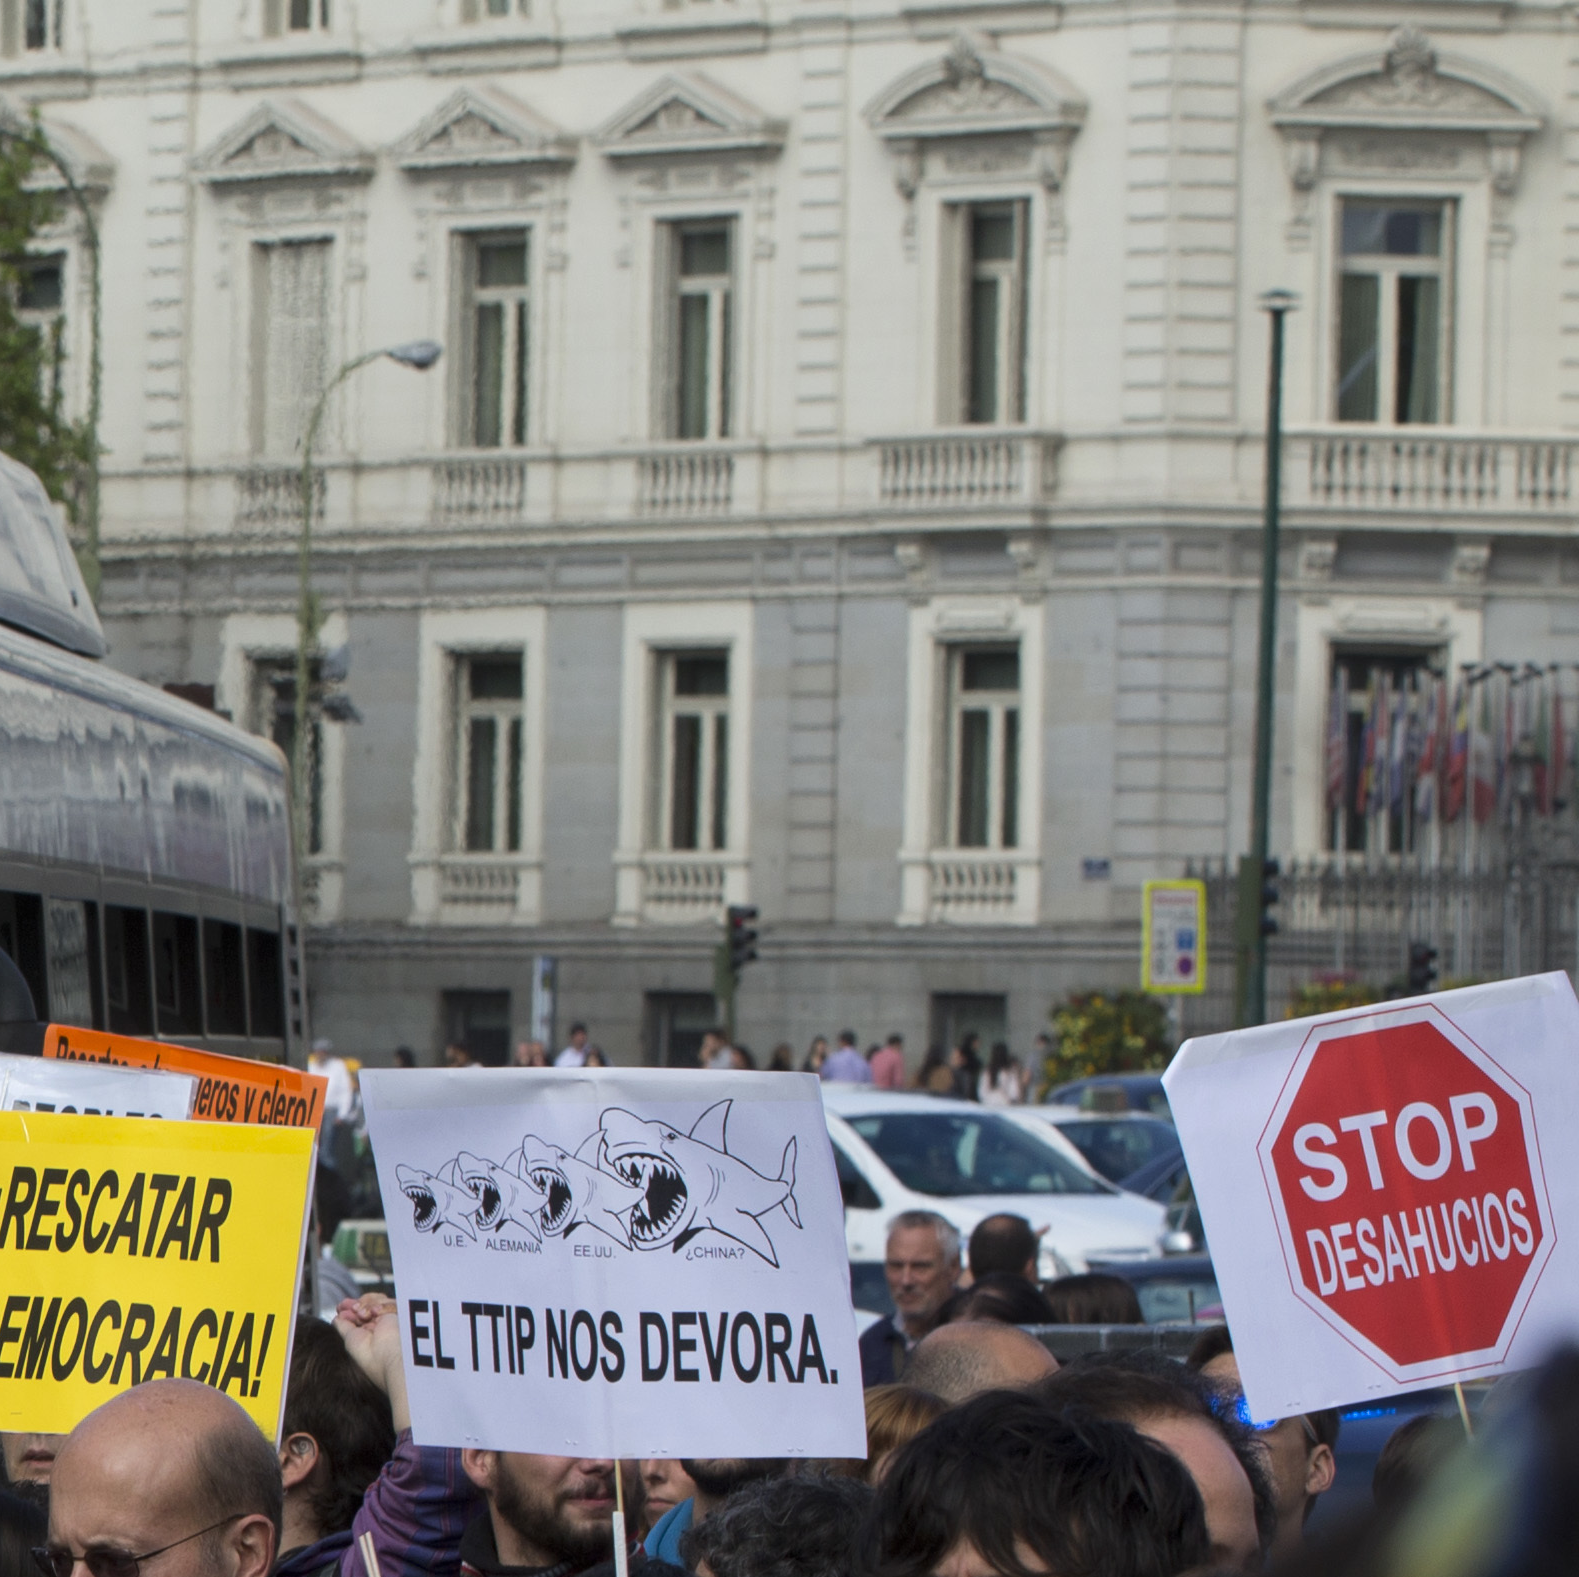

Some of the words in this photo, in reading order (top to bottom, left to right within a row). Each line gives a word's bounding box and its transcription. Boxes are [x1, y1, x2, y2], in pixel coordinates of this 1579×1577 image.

[1292, 1091, 1499, 1202] STOP
[442, 1234, 468, 1248] U.E.
[485, 1238, 543, 1255] ALEMANIA
[1305, 1186, 1535, 1297] DESAHUCIOS
[573, 1244, 617, 1260] EE.UU.
[685, 1245, 746, 1262] ¿CHINA?
[408, 1298, 455, 1371] EL
[461, 1301, 536, 1376] TTIP
[545, 1307, 626, 1384] NOS
[639, 1310, 840, 1385] DEVORA.
